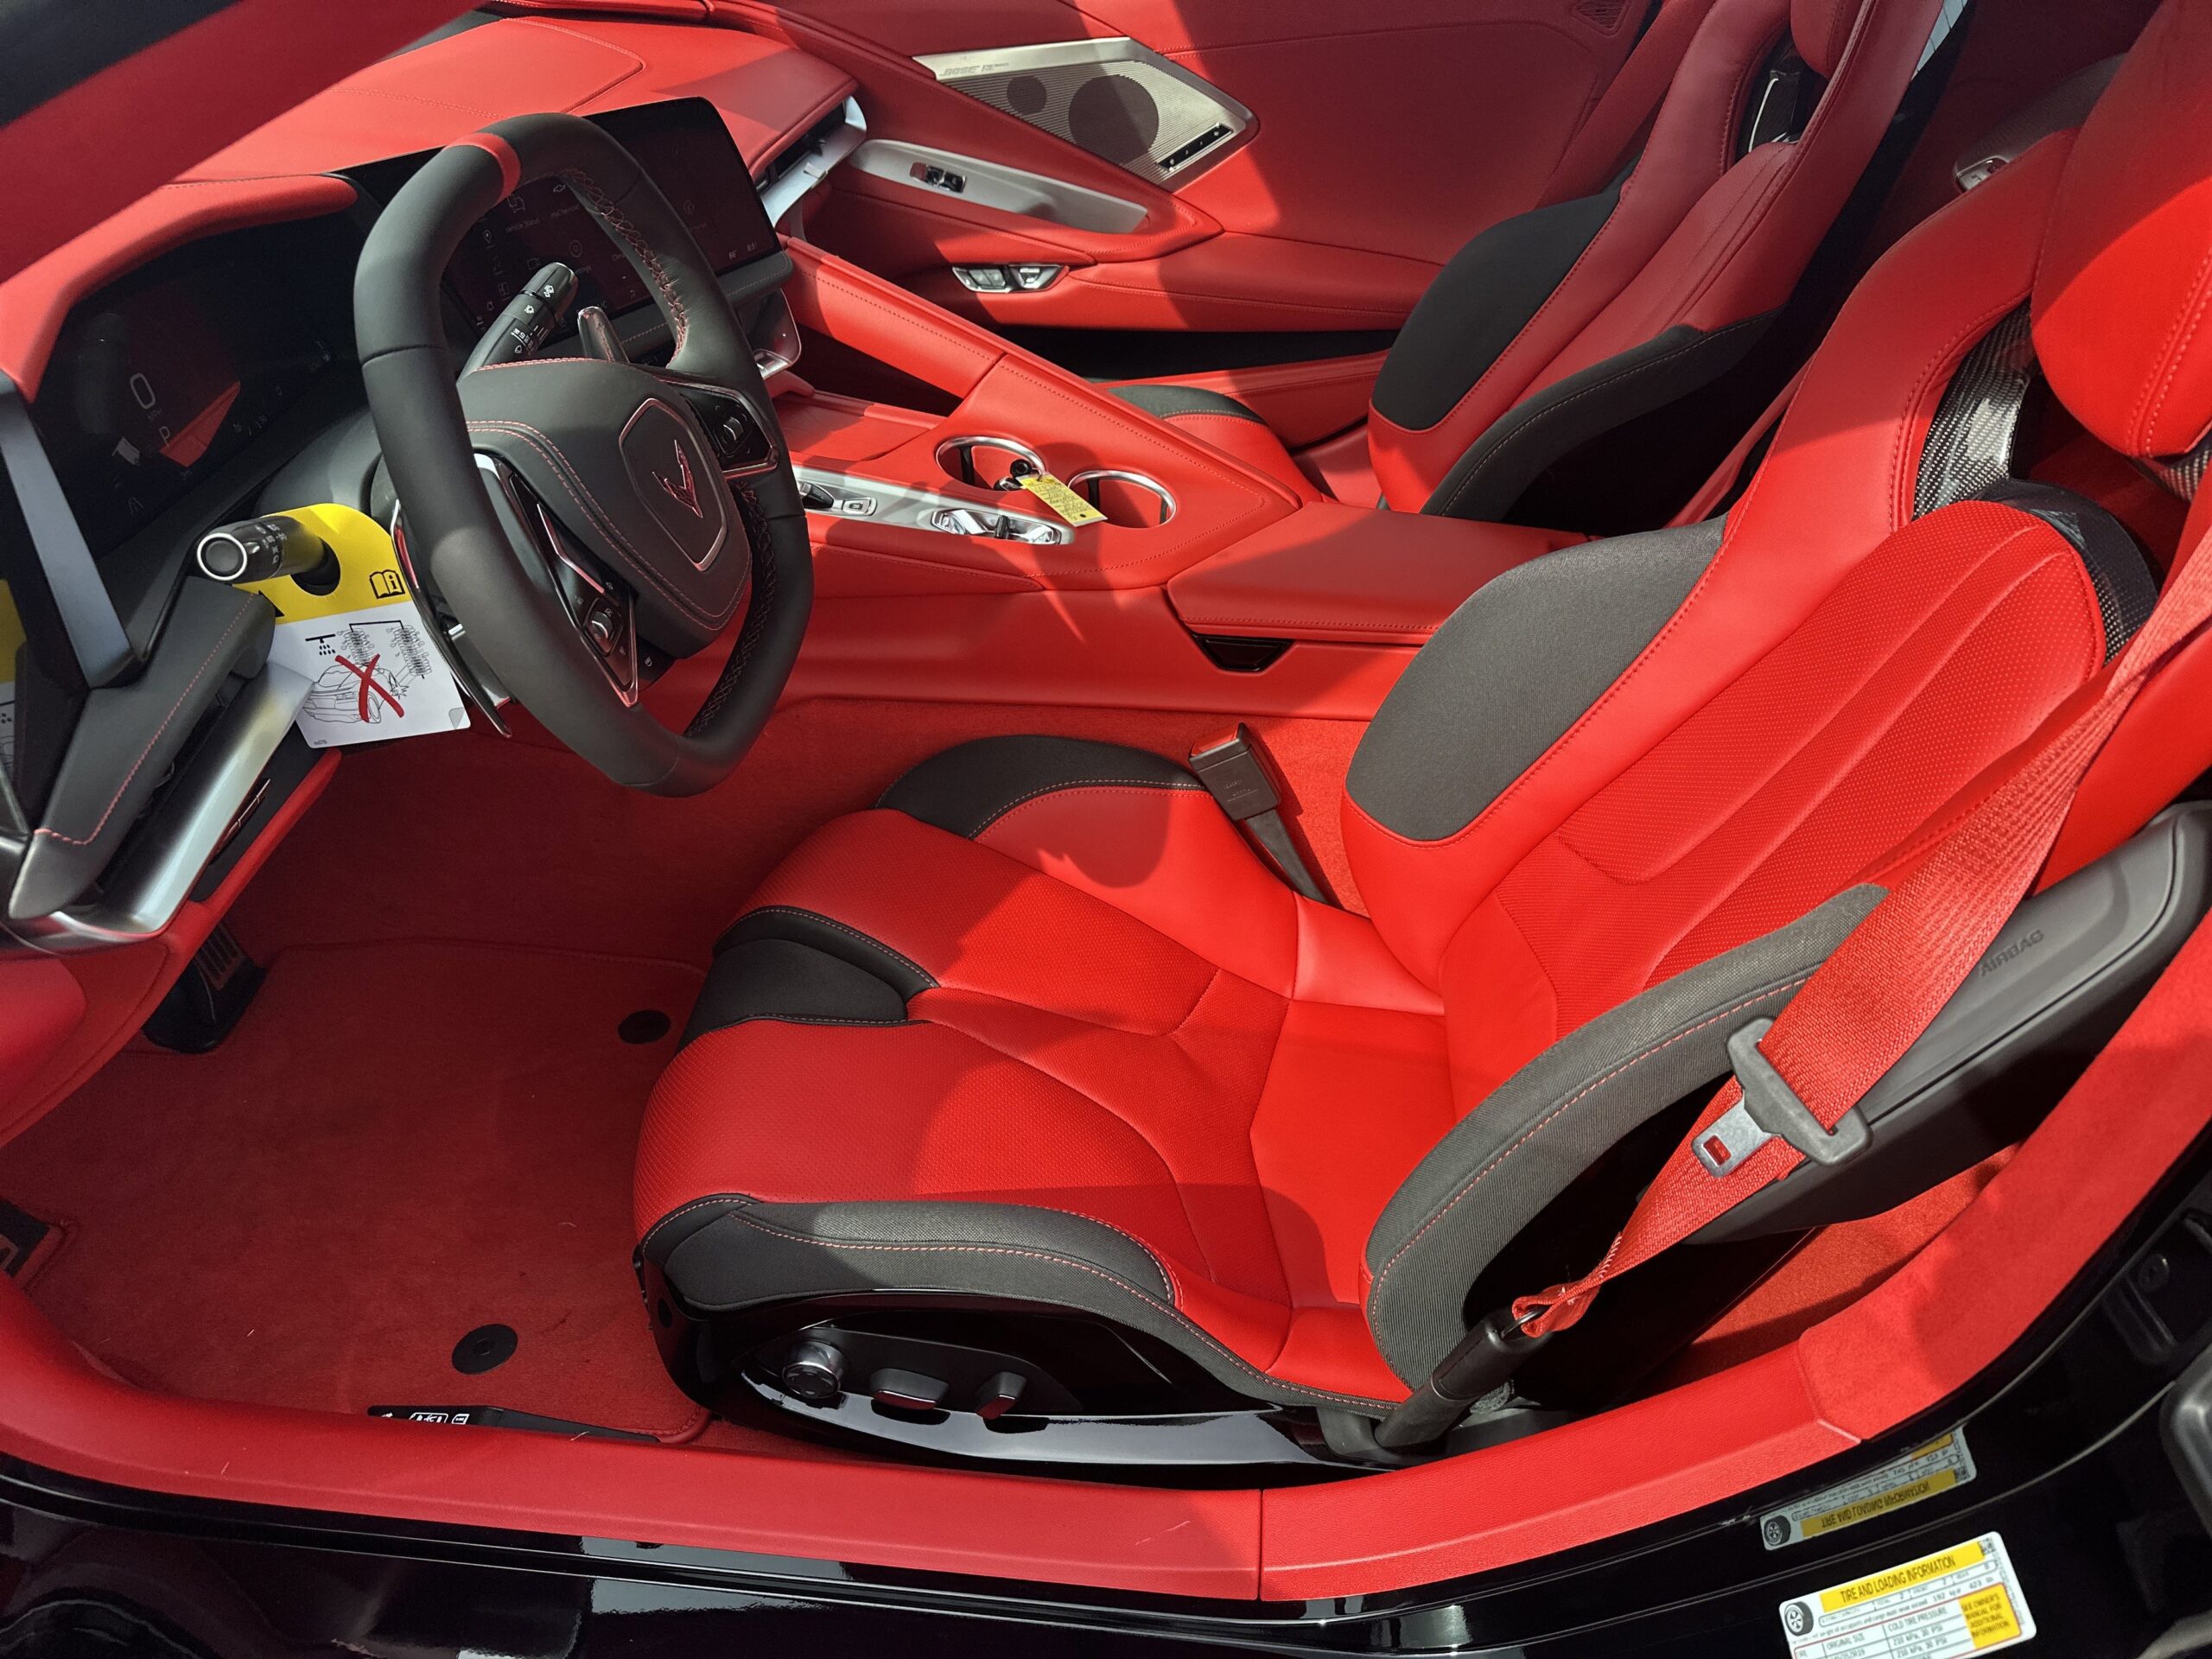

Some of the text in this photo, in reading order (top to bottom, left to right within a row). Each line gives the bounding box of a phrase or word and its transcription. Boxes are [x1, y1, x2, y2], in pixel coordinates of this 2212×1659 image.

[1981, 929, 2044, 977] AIRBAG
[1840, 1589, 1858, 1603] TIRE
[1858, 1583, 1873, 1597] AND
[1873, 1572, 1906, 1592] LOADING
[1906, 1555, 1956, 1582] INFORMATION
